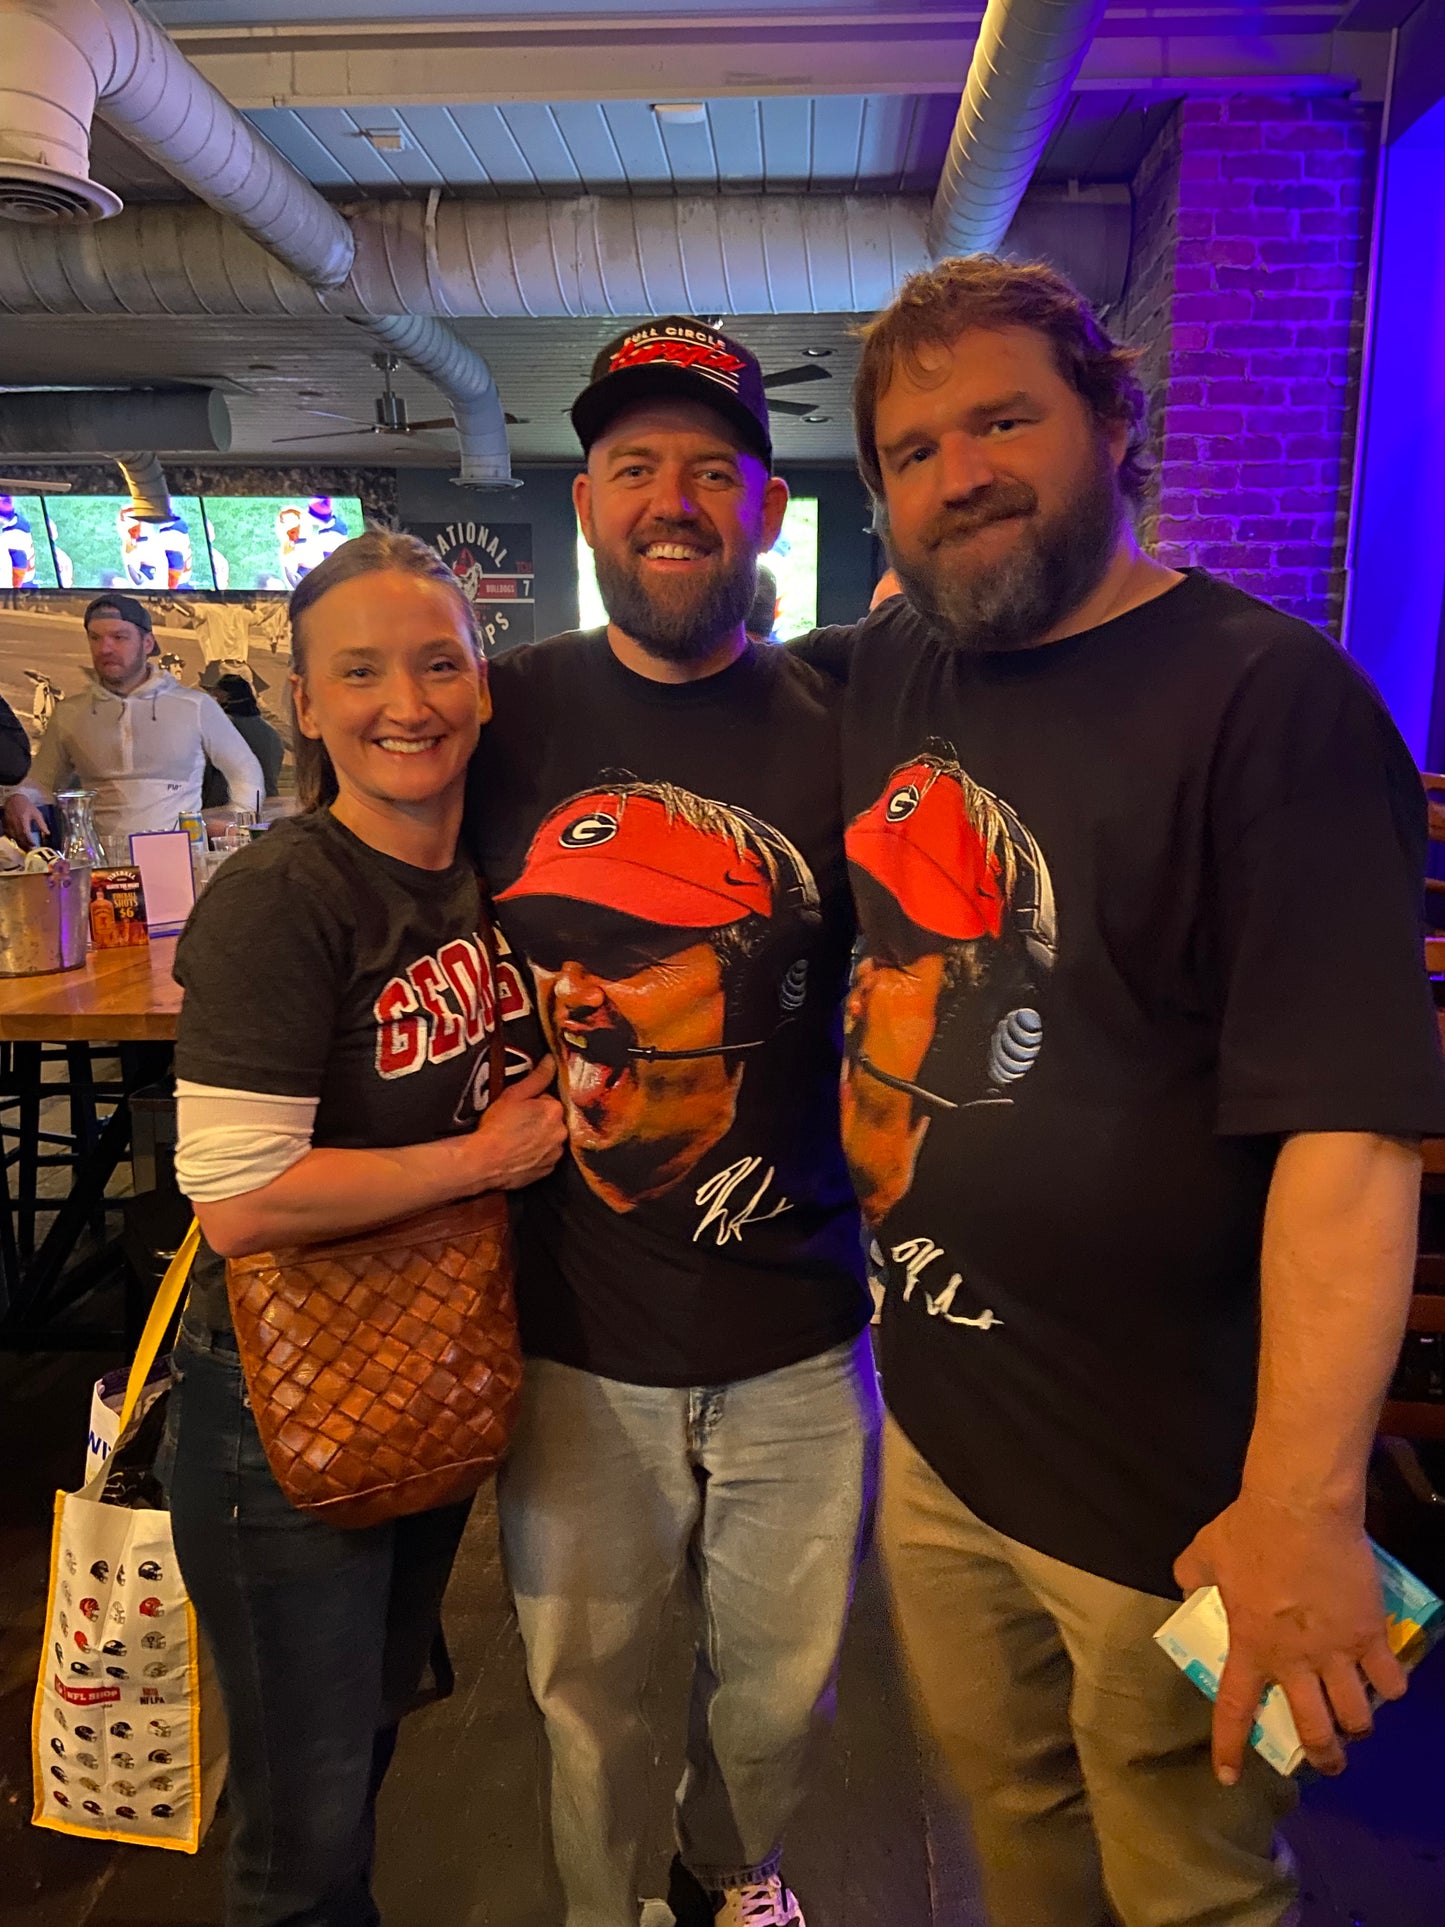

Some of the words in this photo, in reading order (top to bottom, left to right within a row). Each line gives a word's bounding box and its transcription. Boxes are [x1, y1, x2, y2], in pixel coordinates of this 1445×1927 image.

[623, 328, 659, 347] FULL
[665, 326, 726, 351] CIRCLE
[436, 521, 508, 568] ATIONAL
[522, 580, 530, 597] 7
[886, 785, 919, 822] G
[558, 812, 619, 849] G
[120, 908, 134, 917] $6
[68, 1691, 87, 1701] NFL
[89, 1689, 118, 1701] SHOP
